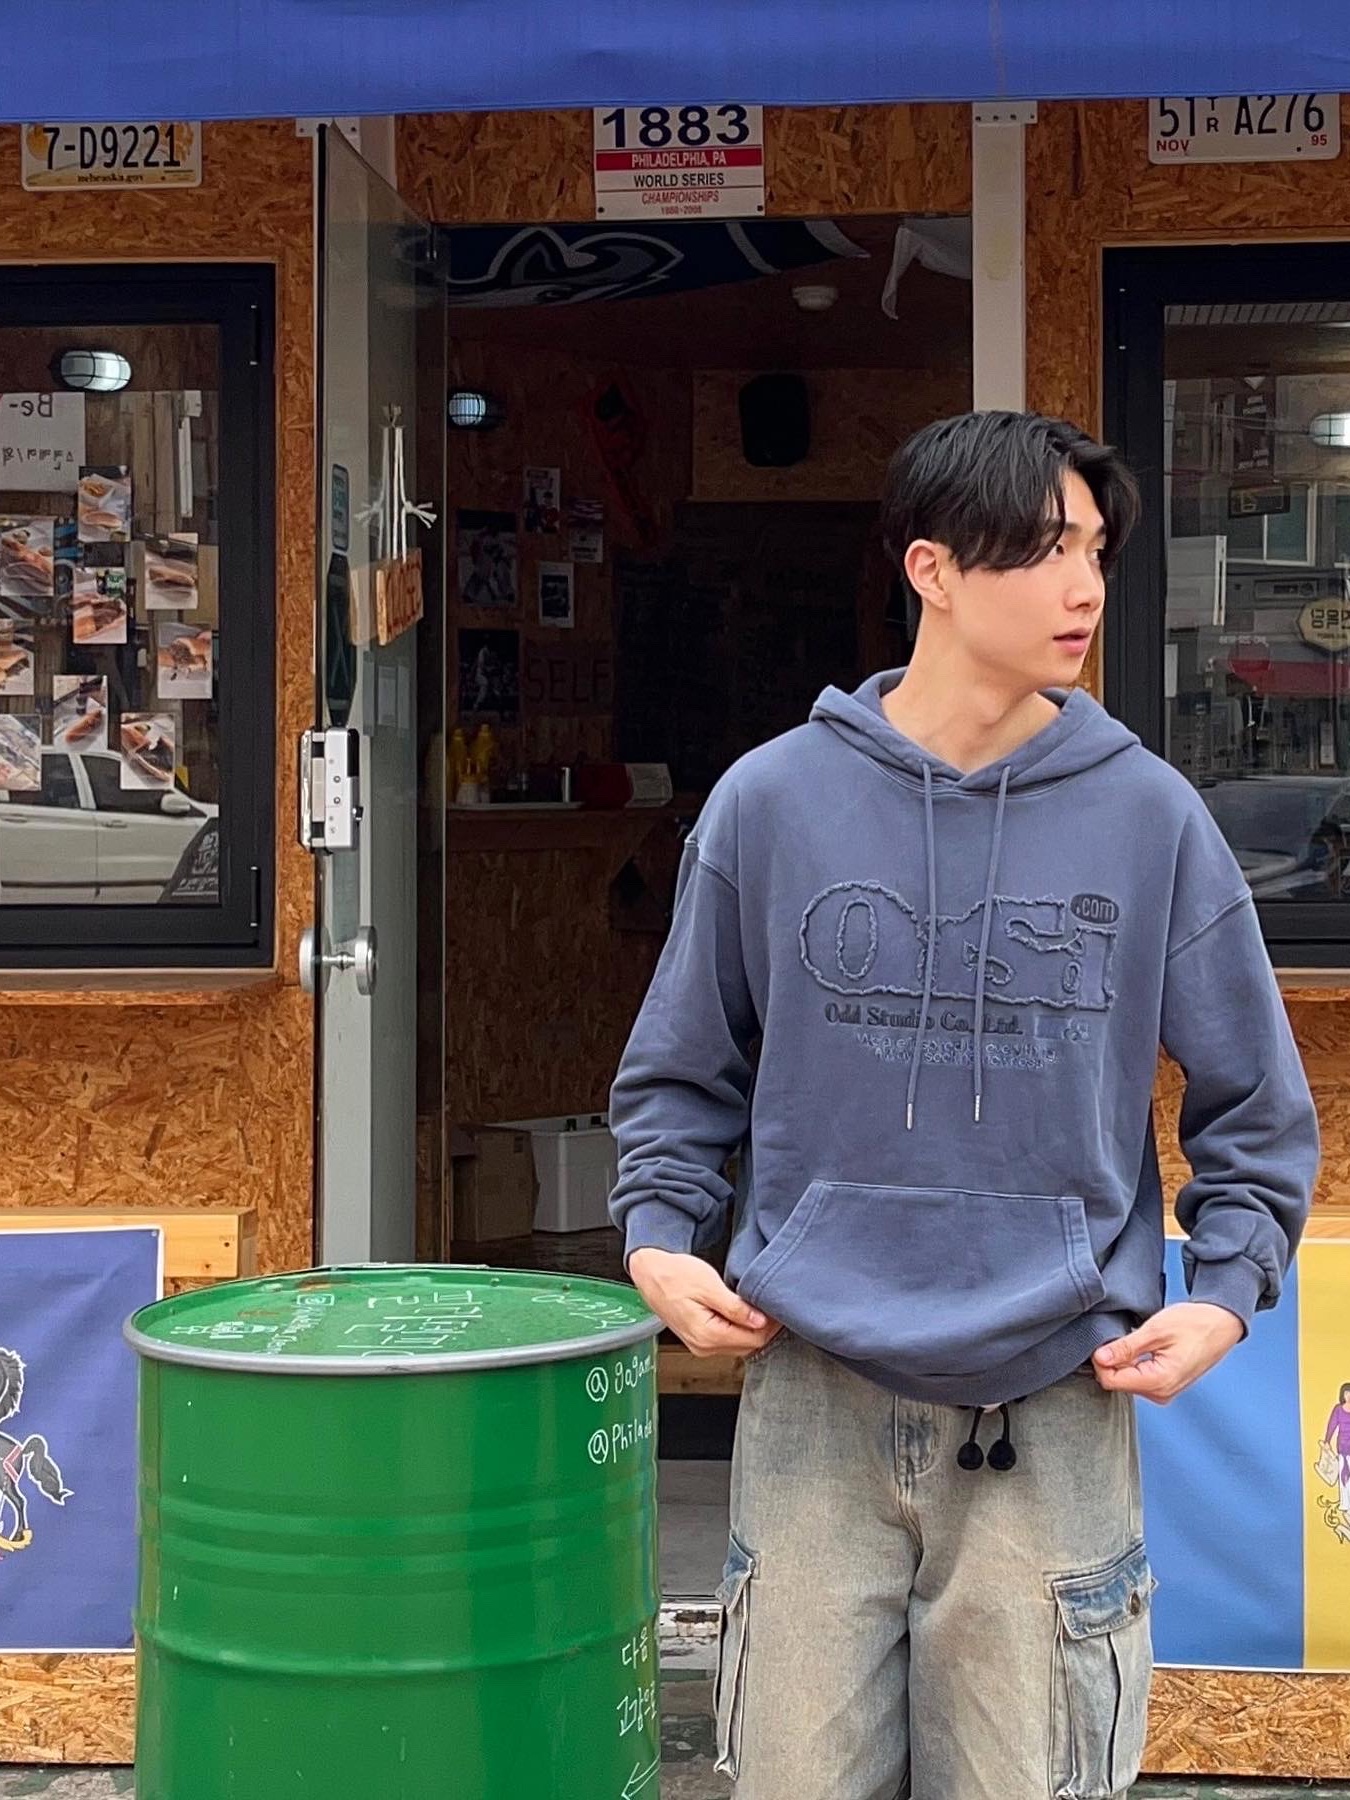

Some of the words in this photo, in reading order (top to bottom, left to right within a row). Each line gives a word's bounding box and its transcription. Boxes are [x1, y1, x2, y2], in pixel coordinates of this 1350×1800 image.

[602, 104, 751, 148] 1883
[1159, 97, 1196, 137] 51
[1234, 93, 1325, 135] A276
[43, 124, 182, 170] 7-D9221
[1156, 140, 1190, 152] NOV
[1311, 134, 1327, 146] 95
[631, 152, 711, 168] PHILADELPHIA,
[712, 150, 727, 166] PA
[633, 174, 678, 188] WORLD
[682, 172, 725, 186] SERIES
[641, 190, 720, 205] CHAMPIONSHIPS
[524, 656, 611, 705] SELF
[1074, 896, 1116, 921] .com
[824, 1002, 861, 1025] Odd
[866, 1006, 935, 1030] Studio
[621, 1626, 648, 1670] 다음
